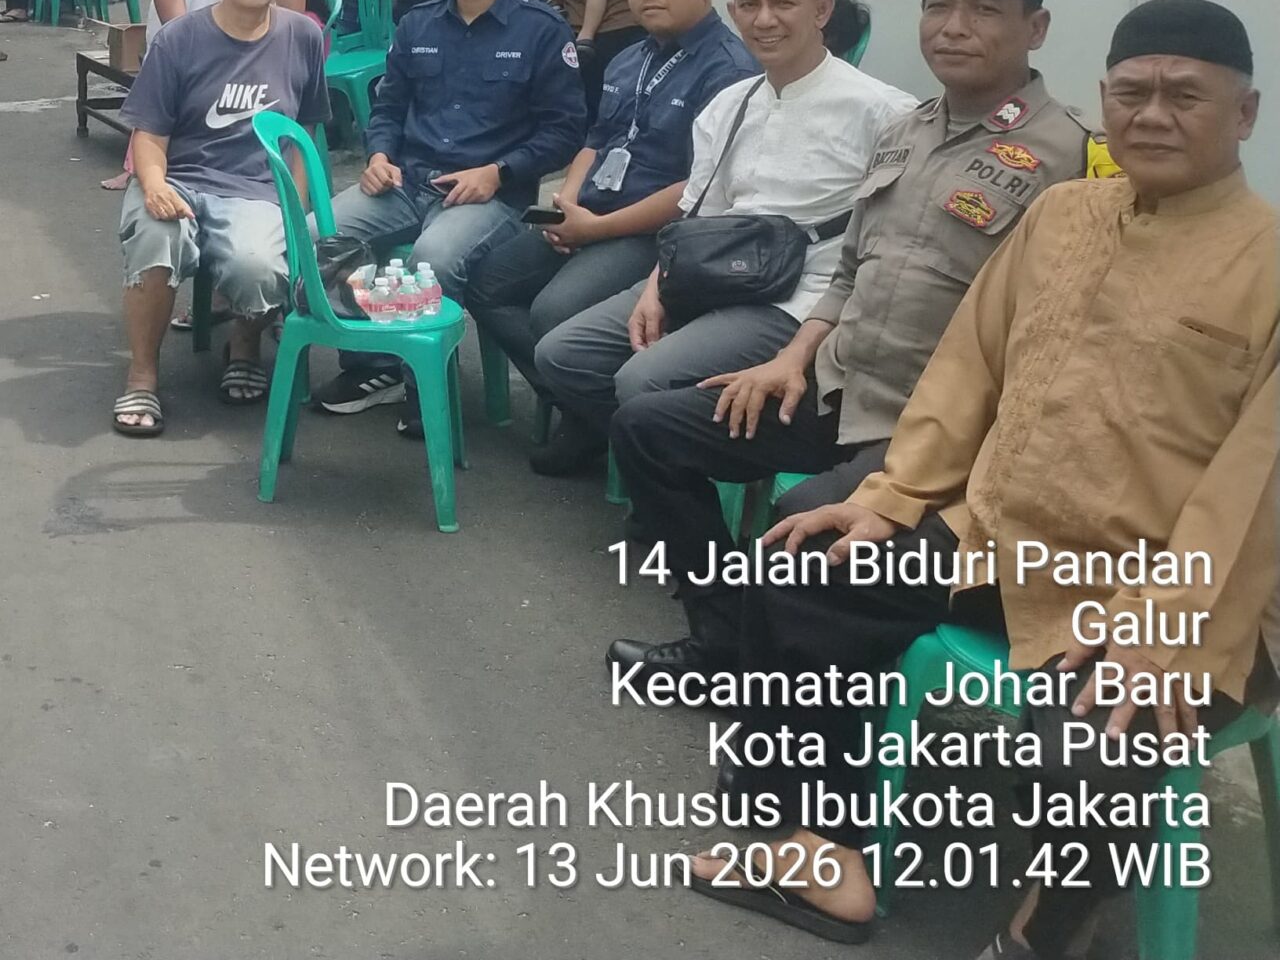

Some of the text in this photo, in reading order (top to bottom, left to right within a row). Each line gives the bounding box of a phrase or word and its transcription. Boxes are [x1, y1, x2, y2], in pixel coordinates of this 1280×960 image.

[495, 50, 522, 59] DRIVER
[218, 83, 269, 110] NIKE
[965, 158, 1031, 198] POLRI
